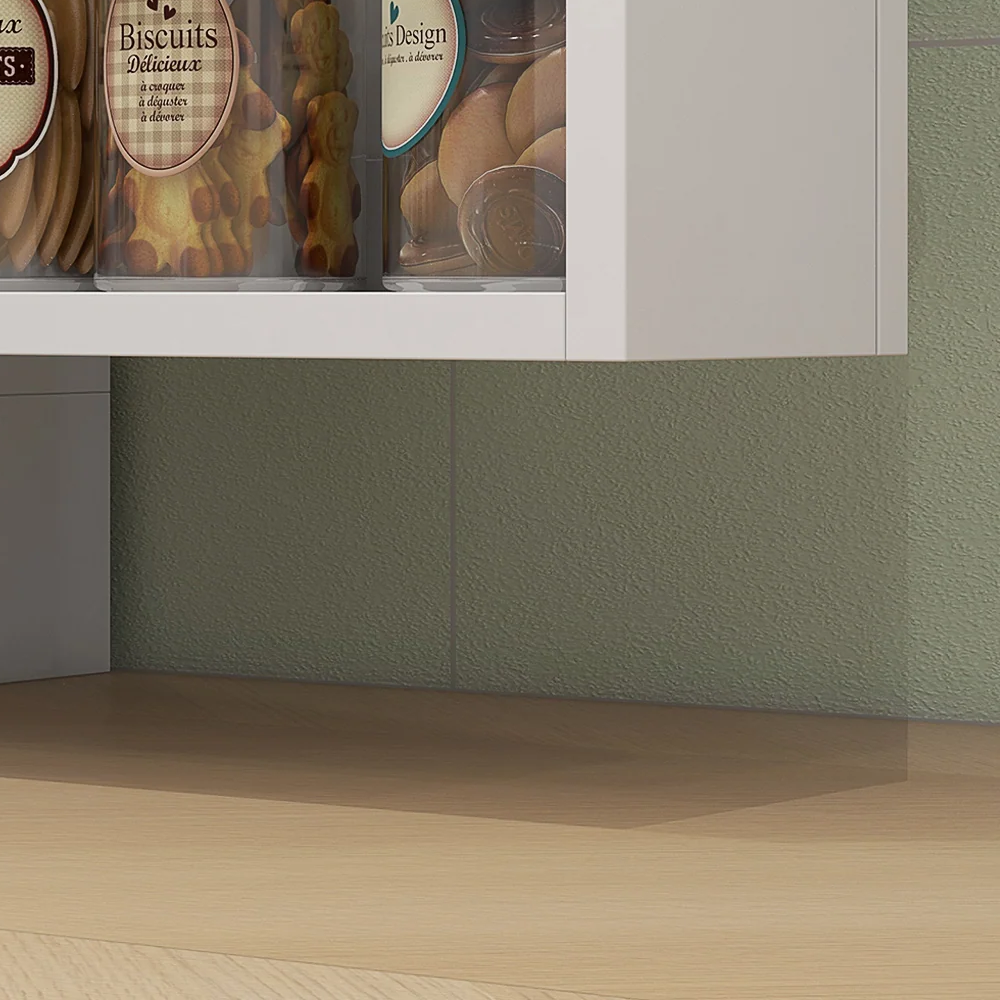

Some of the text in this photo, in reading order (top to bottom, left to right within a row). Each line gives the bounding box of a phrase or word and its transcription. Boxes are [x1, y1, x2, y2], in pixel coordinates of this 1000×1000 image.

[119, 19, 218, 51] Biscuits
[396, 22, 446, 50] Design
[127, 54, 202, 74] Délicieux
[141, 80, 186, 94] à croquer
[138, 96, 188, 110] à déguster
[140, 111, 186, 122] à dévorer
